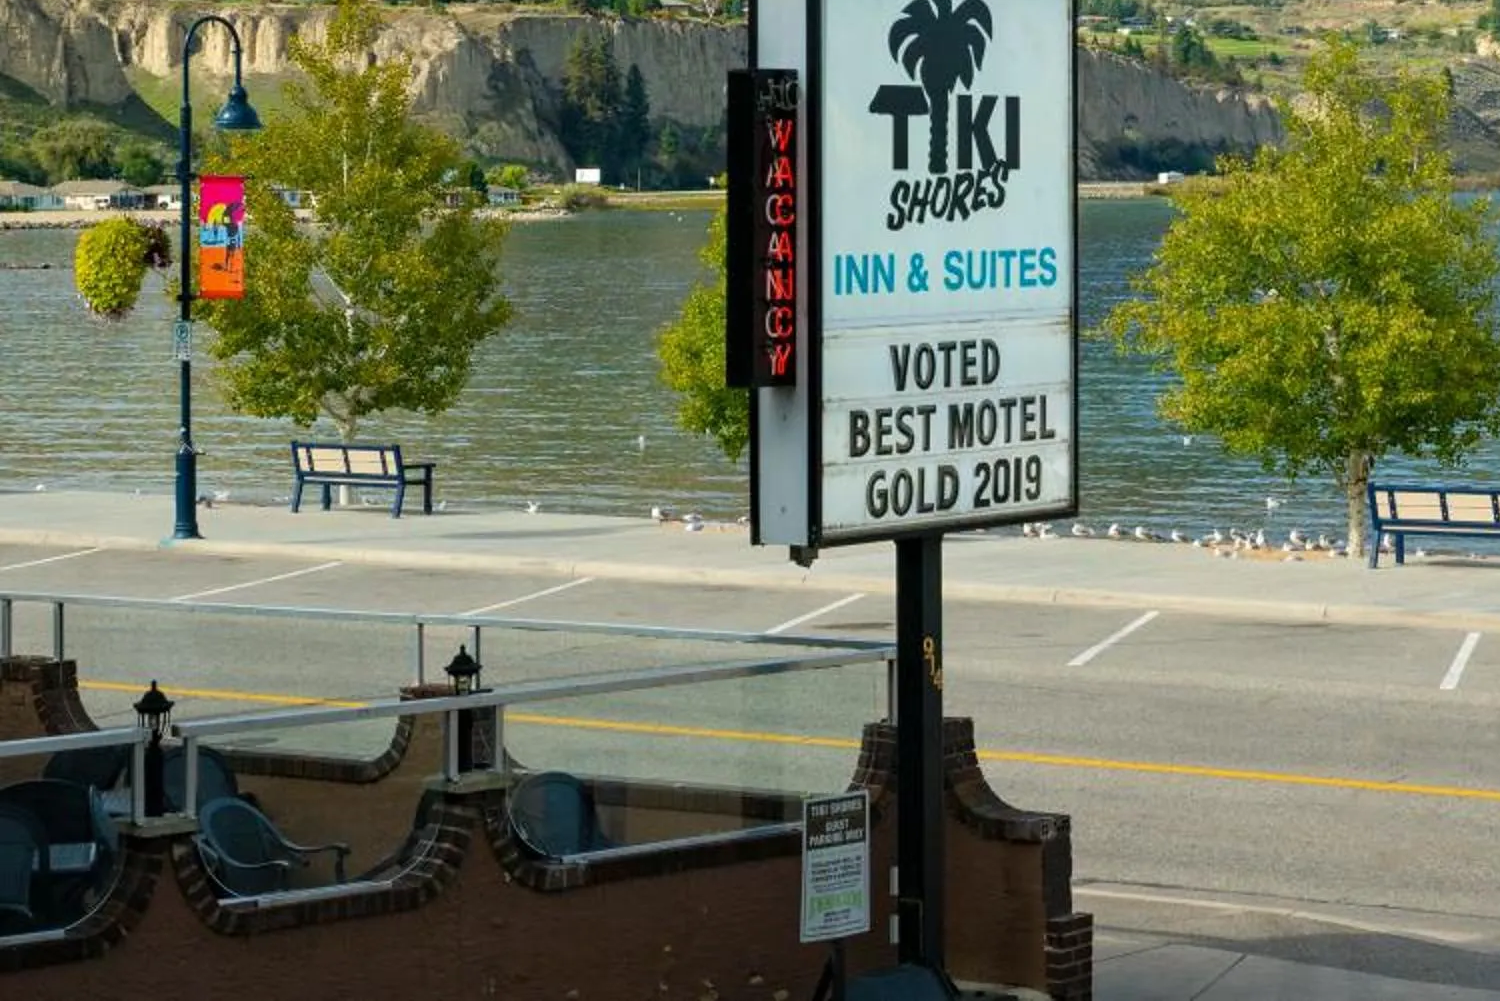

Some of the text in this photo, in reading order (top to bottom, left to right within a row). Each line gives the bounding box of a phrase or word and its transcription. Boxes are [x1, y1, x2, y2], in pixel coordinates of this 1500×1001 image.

[869, 78, 1021, 174] TIKI
[887, 159, 1009, 231] SHORES
[767, 117, 795, 376] VACANCY
[834, 246, 1057, 295] INN & SUITES
[889, 338, 1001, 392] VOTED
[849, 395, 1056, 457] BEST MOTEL
[865, 454, 1042, 519] GOLD 2019
